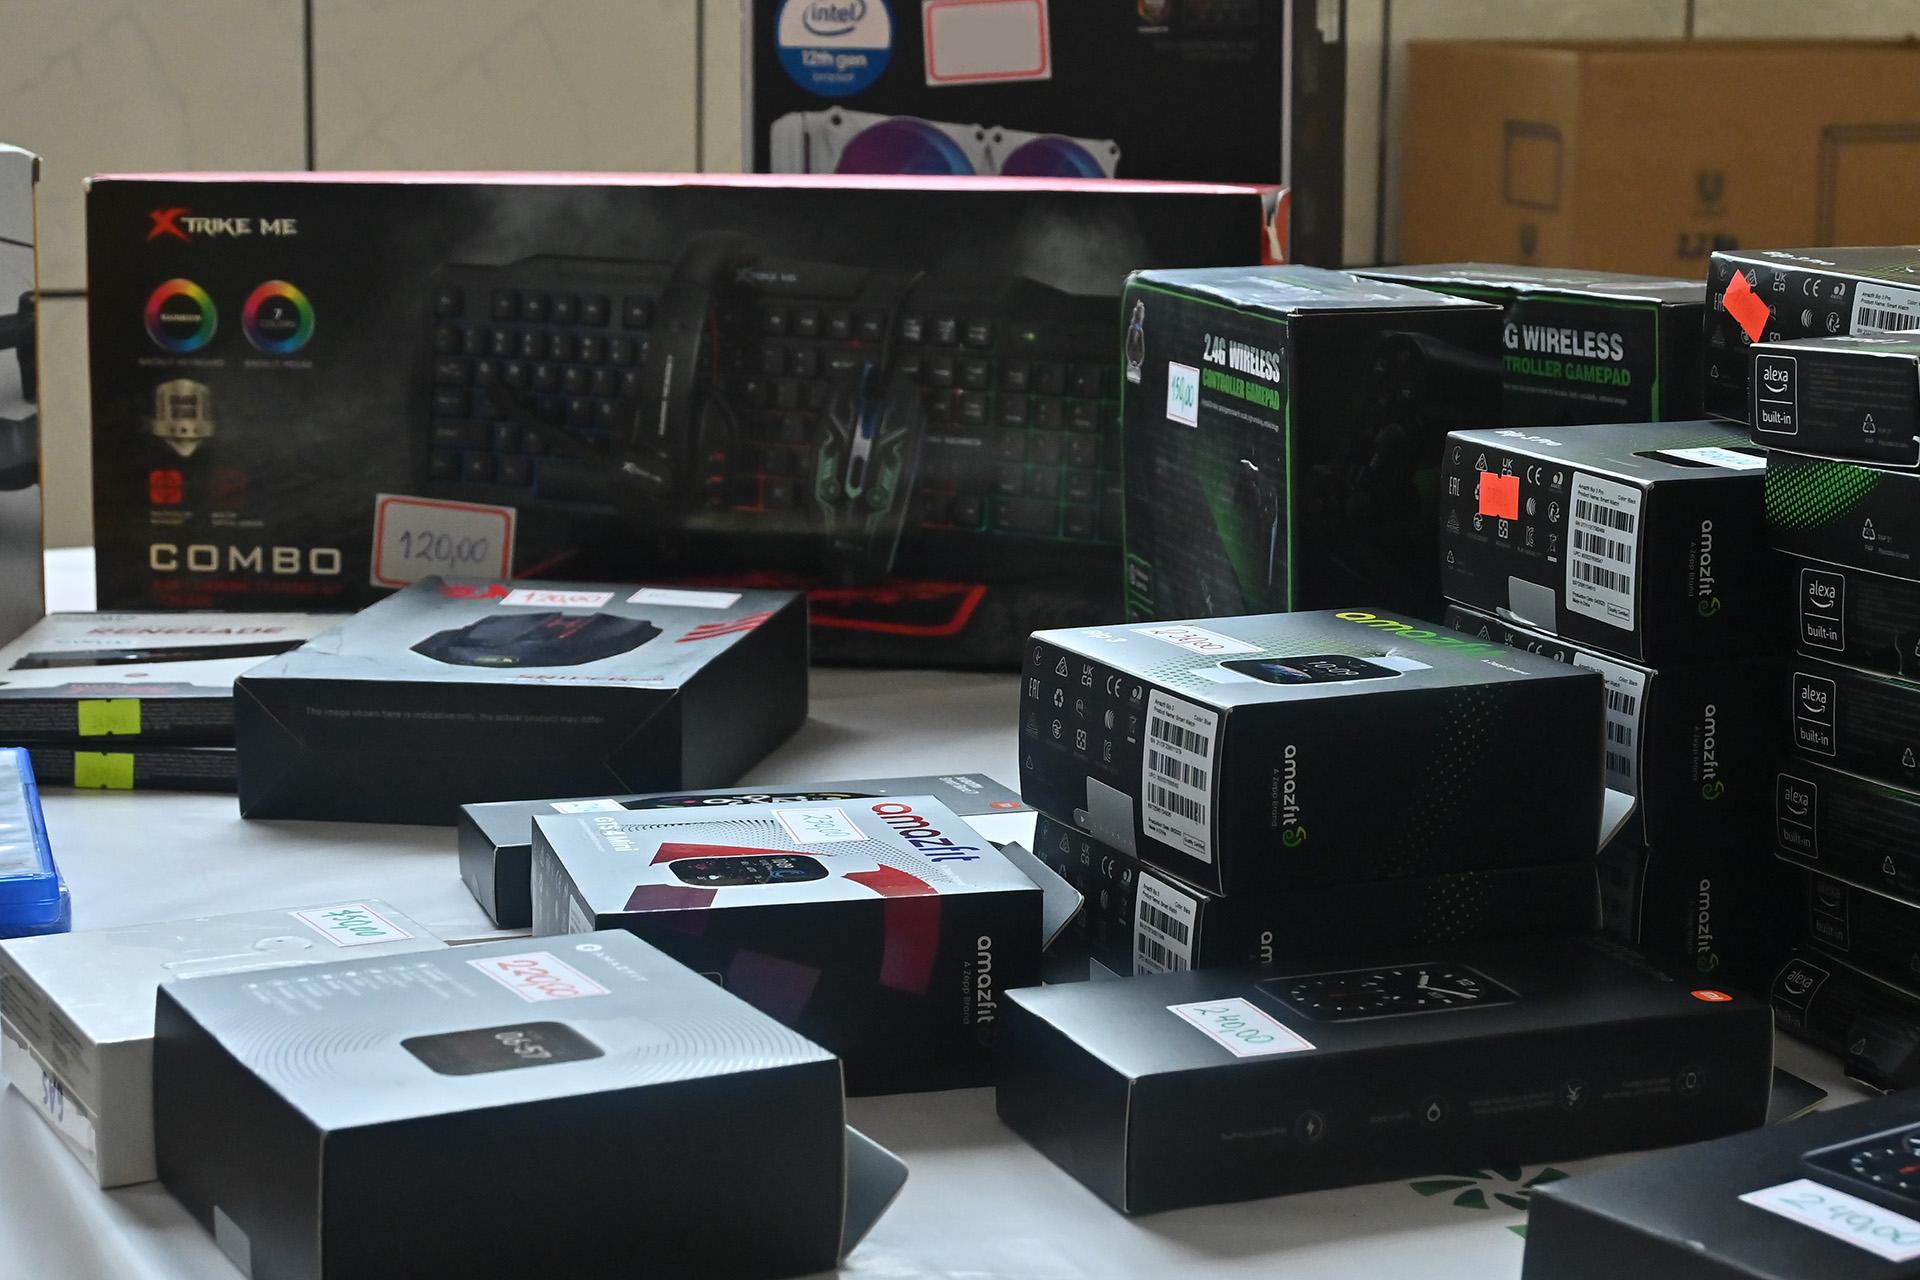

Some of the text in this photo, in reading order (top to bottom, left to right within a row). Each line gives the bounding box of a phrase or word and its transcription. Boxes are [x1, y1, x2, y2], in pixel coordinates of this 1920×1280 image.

[259, 218, 298, 236] ME
[1522, 324, 1624, 361] WIRELESS
[1203, 333, 1281, 383] 2.4G WIRELESS
[1565, 362, 1631, 386] GAMEPAD
[1763, 365, 1789, 382] alexa
[1202, 367, 1280, 411] CONTROLLER GAMEPAD
[1762, 410, 1791, 425] built-in
[1527, 465, 1542, 486] CE
[150, 543, 342, 575] COMBO
[399, 529, 489, 568] 120,00
[1699, 520, 1715, 596] amazfit
[1809, 580, 1836, 599] alexa
[1807, 623, 1838, 641] built-in
[1107, 675, 1122, 698] CE
[1801, 686, 1827, 704] alexa
[1703, 704, 1718, 780] amazfit
[1800, 727, 1829, 746] built-in
[1283, 744, 1300, 826] amazfit
[1784, 785, 1809, 805] alexa
[871, 803, 981, 863] amazfit
[1783, 827, 1811, 848] built-in
[1698, 879, 1713, 952] amazfit
[977, 935, 998, 1024] amazfit
[1787, 970, 1813, 988] alexa
[1193, 1006, 1274, 1044] 240,00
